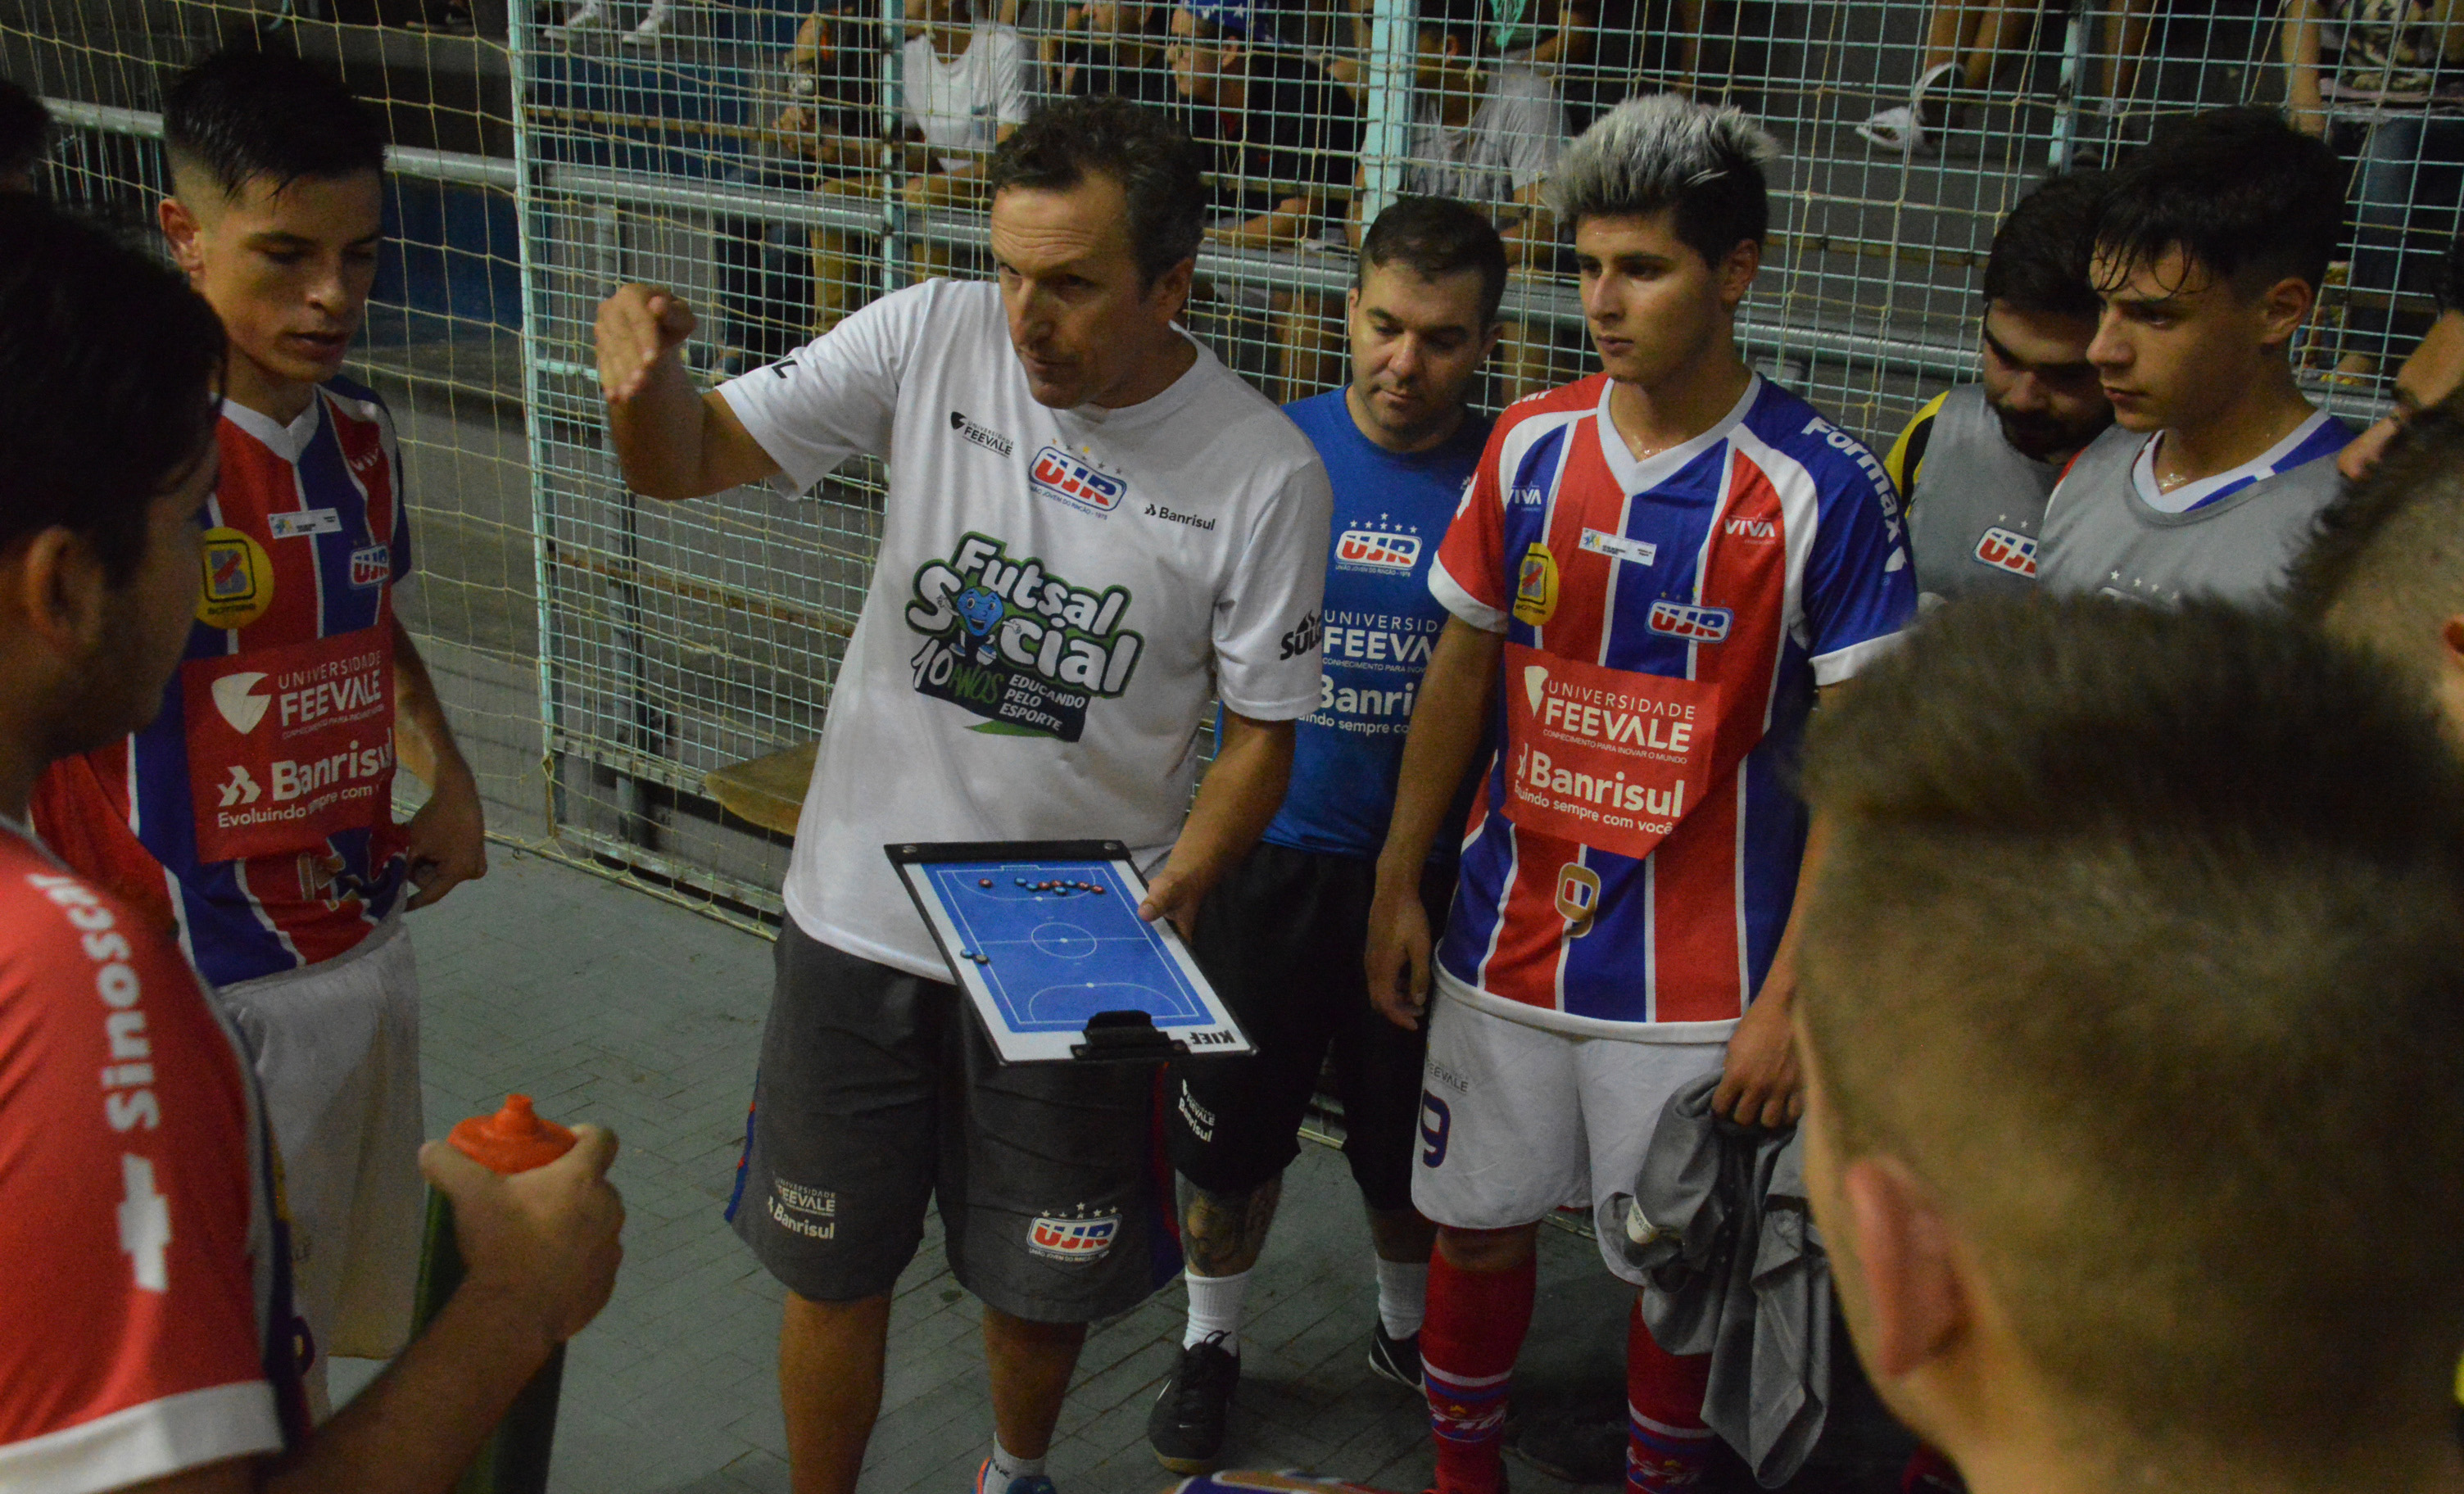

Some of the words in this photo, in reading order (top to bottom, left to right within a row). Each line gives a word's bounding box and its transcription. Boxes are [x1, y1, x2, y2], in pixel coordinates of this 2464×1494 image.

[963, 426, 1013, 455] FEEVALE
[1034, 452, 1117, 507] UJR
[1800, 416, 1901, 544] Formax
[1159, 506, 1216, 532] Banrisul
[1724, 518, 1776, 538] VIVA
[1341, 534, 1416, 565] UJR
[953, 536, 1125, 637] Futsal
[1651, 605, 1725, 638] UJR
[277, 650, 382, 690] UNIVERSIDADE
[910, 638, 954, 689] 10
[947, 662, 1005, 705] ANOS
[1322, 657, 1384, 672] CONHECIMENTO
[279, 668, 383, 727] FEEVALE
[1004, 688, 1041, 709] PELO
[1008, 672, 1086, 709] EDUCANDO
[1547, 680, 1696, 721] UNIVERSIDADE
[999, 702, 1063, 731] ESPORTE
[1338, 719, 1390, 737] sempre
[1543, 696, 1693, 754] FEEVALE
[271, 726, 394, 802] Banrisul
[1542, 728, 1597, 749] CONHECIMENTO
[1597, 742, 1617, 753] PARA
[1618, 746, 1647, 758] INOVAR
[1648, 751, 1656, 759] O
[1656, 753, 1688, 765] MUNDO
[1529, 749, 1685, 818] Banrisul
[218, 803, 307, 829] Evoluindo
[341, 785, 373, 800] com
[1552, 799, 1600, 822] sempre
[1603, 813, 1633, 829] com
[1638, 821, 1674, 835] você
[1189, 1030, 1237, 1045] KIEF
[1420, 1088, 1452, 1169] 9
[773, 1202, 835, 1240] Banrisul
[1035, 1222, 1115, 1249] UJR
